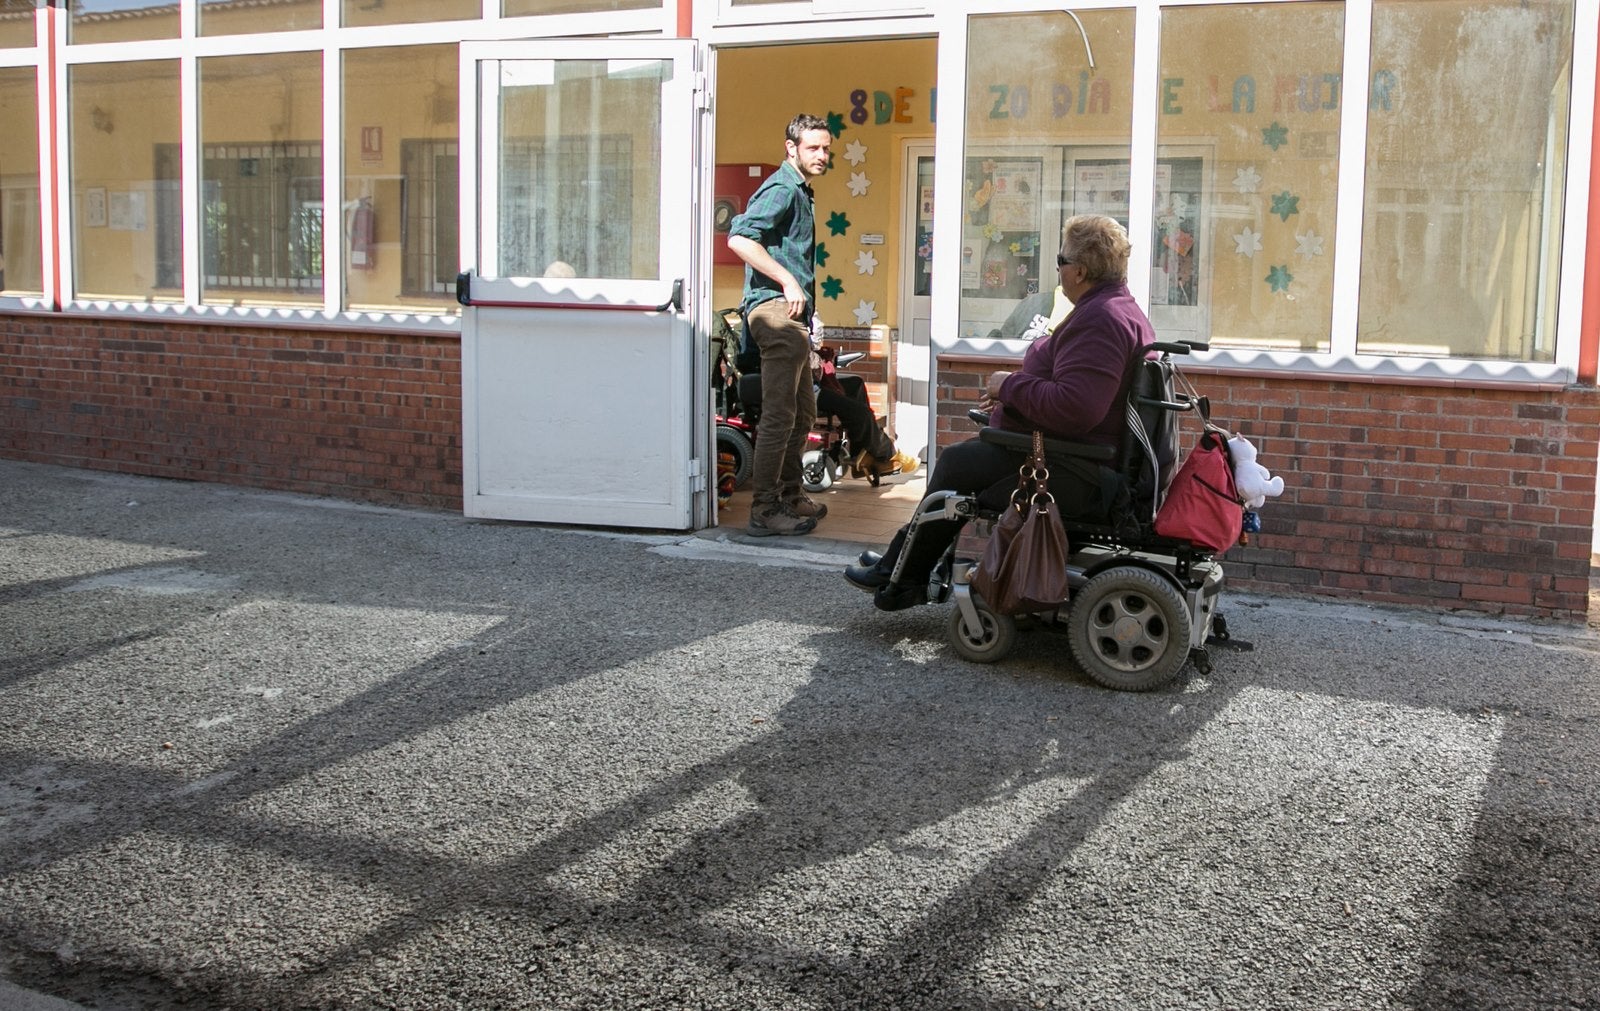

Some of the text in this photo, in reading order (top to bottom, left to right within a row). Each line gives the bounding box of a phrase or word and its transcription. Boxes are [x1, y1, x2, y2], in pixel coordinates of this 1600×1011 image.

[1162, 78, 1184, 115] E
[1207, 74, 1257, 114] LA
[1272, 70, 1397, 114] MUJR
